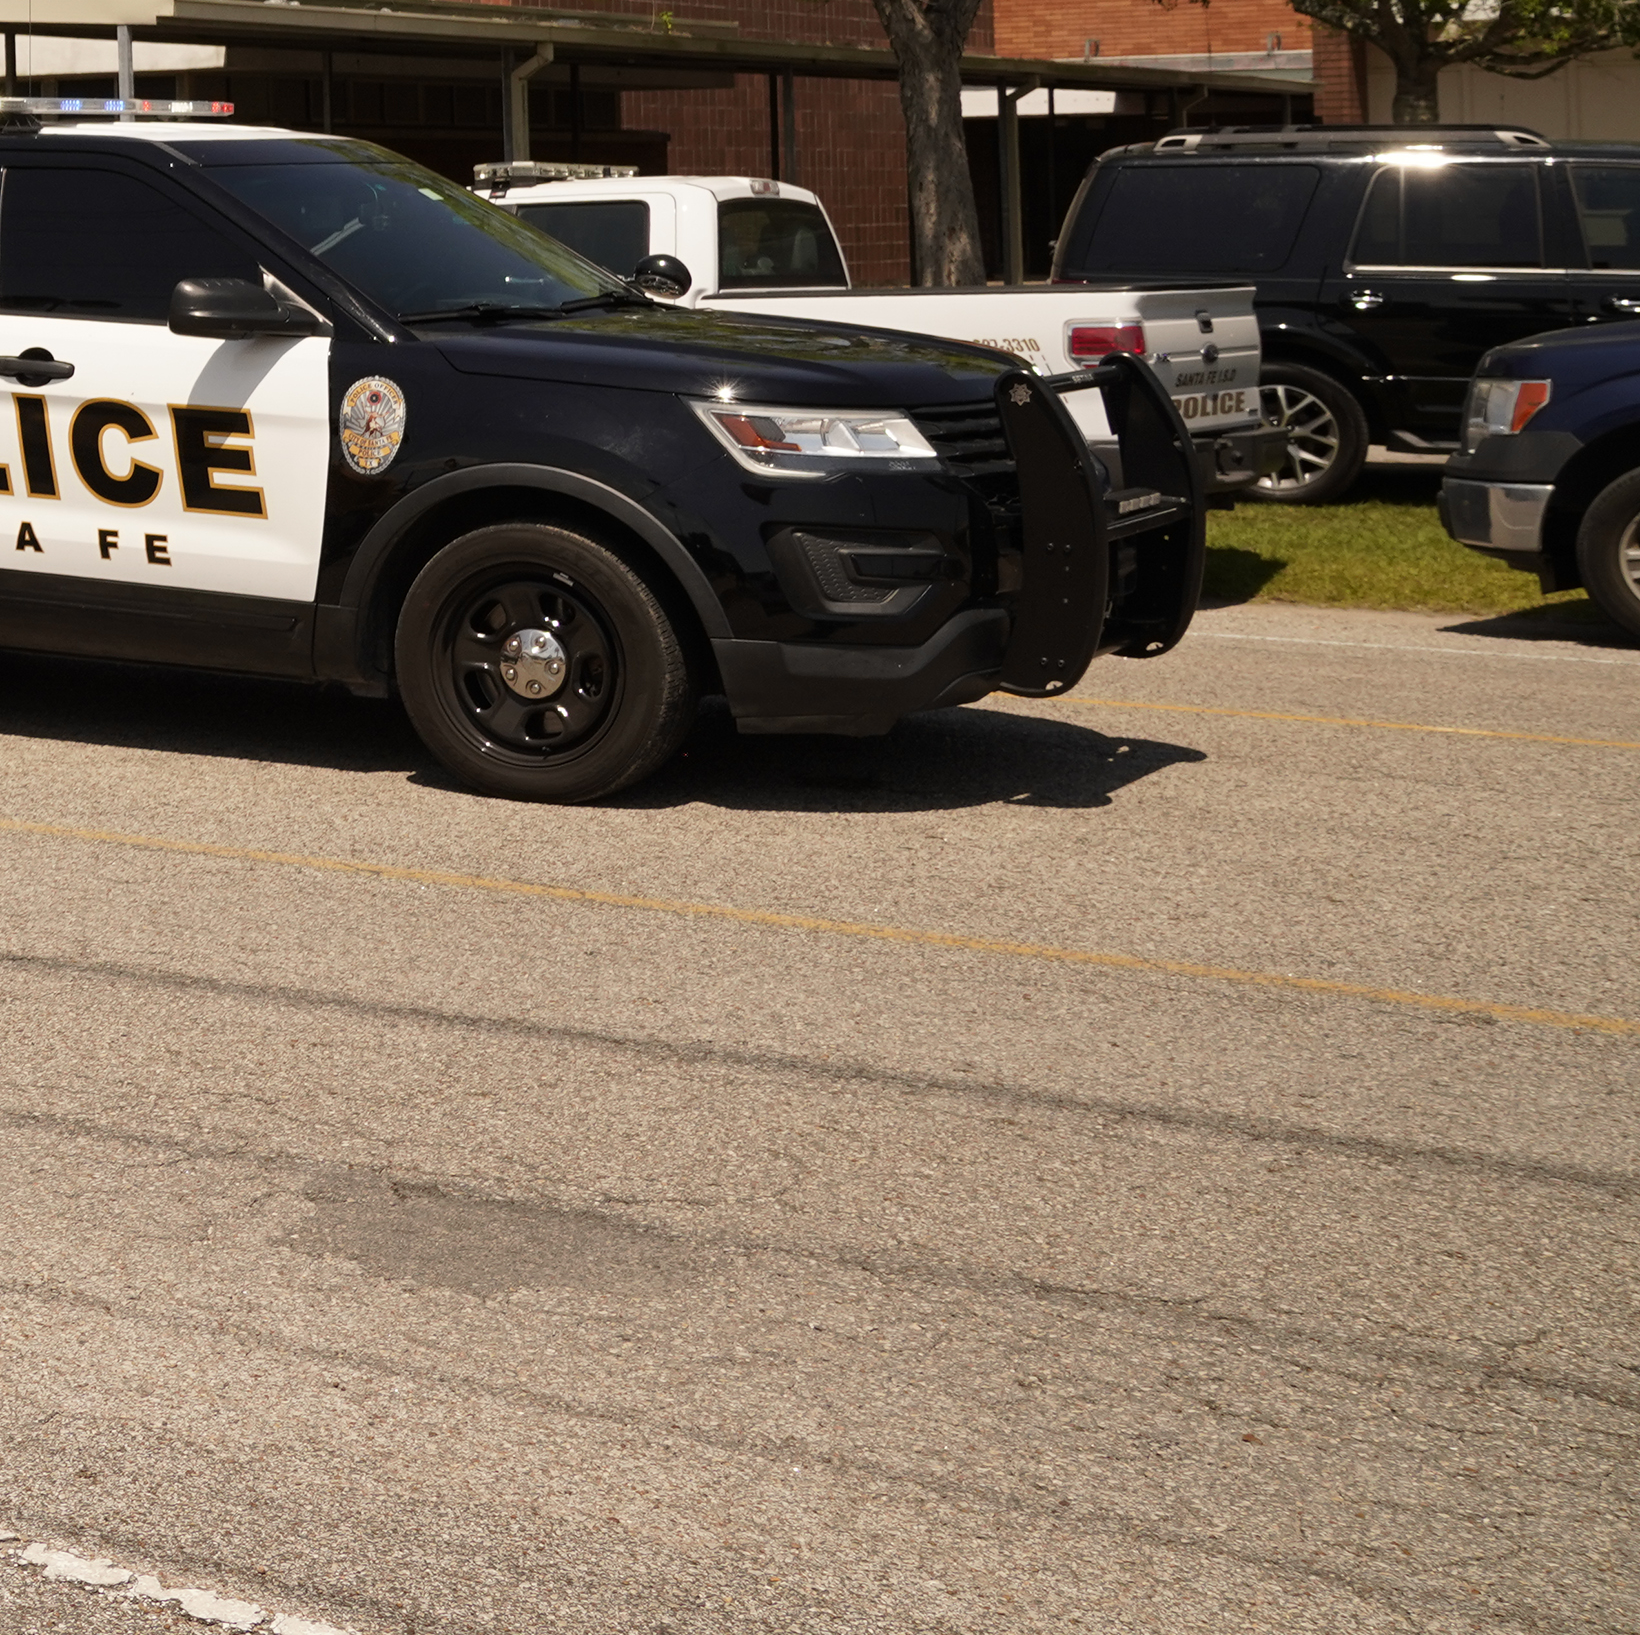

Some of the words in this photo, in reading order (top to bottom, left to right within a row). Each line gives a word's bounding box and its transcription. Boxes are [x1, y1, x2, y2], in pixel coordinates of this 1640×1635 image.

[1175, 372, 1205, 387] SANTA
[1206, 370, 1217, 384] FE
[350, 383, 371, 404] POLICE
[374, 383, 399, 406] OFFICER
[358, 448, 381, 457] POLICE
[97, 527, 172, 567] FE
